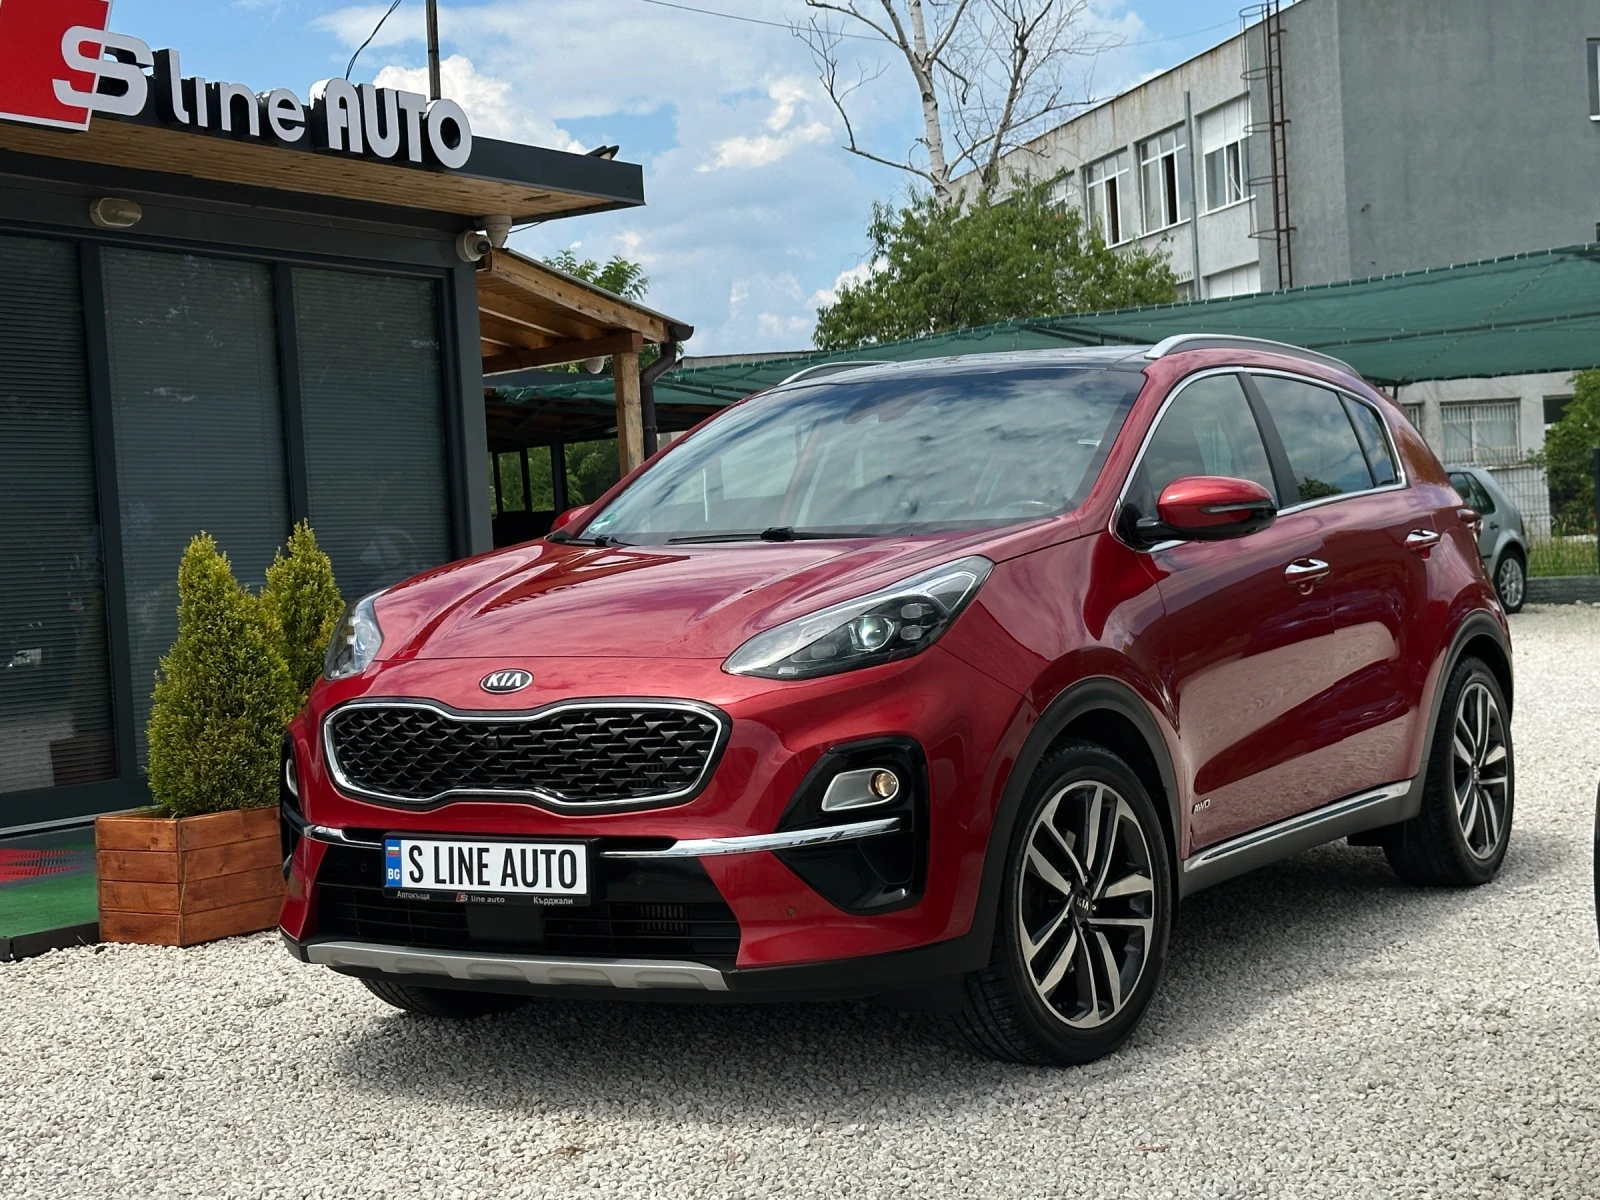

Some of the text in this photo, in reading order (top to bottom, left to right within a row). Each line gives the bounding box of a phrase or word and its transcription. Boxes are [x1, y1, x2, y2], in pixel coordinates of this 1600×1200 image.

[52, 25, 472, 169] S line AUTO
[486, 672, 522, 688] KIA
[1192, 798, 1211, 814] AWD
[387, 868, 400, 880] BG
[408, 844, 577, 889] S LINE AUTO
[486, 895, 506, 903] auto
[533, 895, 574, 906] Кърджали
